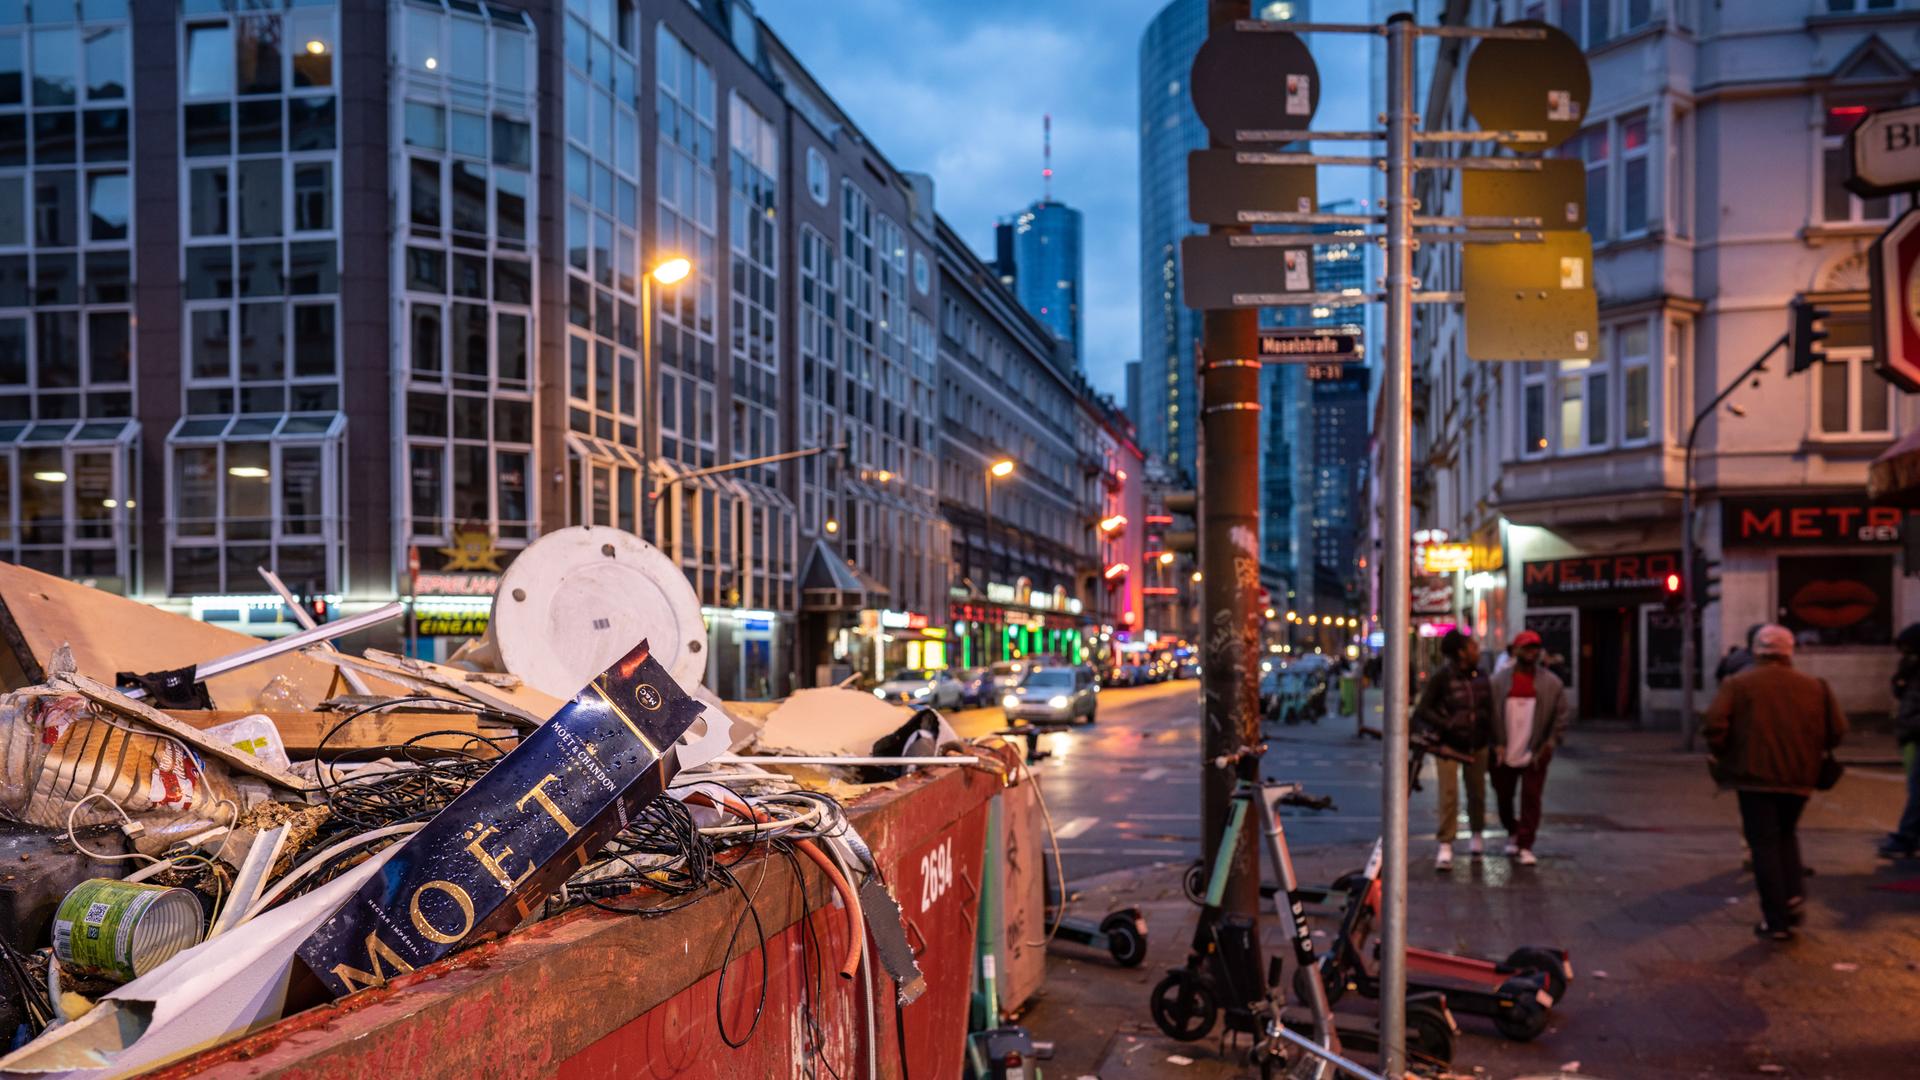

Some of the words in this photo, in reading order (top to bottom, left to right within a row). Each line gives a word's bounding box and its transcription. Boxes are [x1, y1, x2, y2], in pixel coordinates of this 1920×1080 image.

[1742, 507, 1920, 537] METR
[1526, 554, 1676, 584] METRO
[577, 750, 617, 792] CHANDON
[331, 773, 582, 993] MOËT
[921, 836, 953, 914] 2694
[367, 899, 392, 928] NECTAR
[390, 923, 421, 956] IMPÉRIAL
